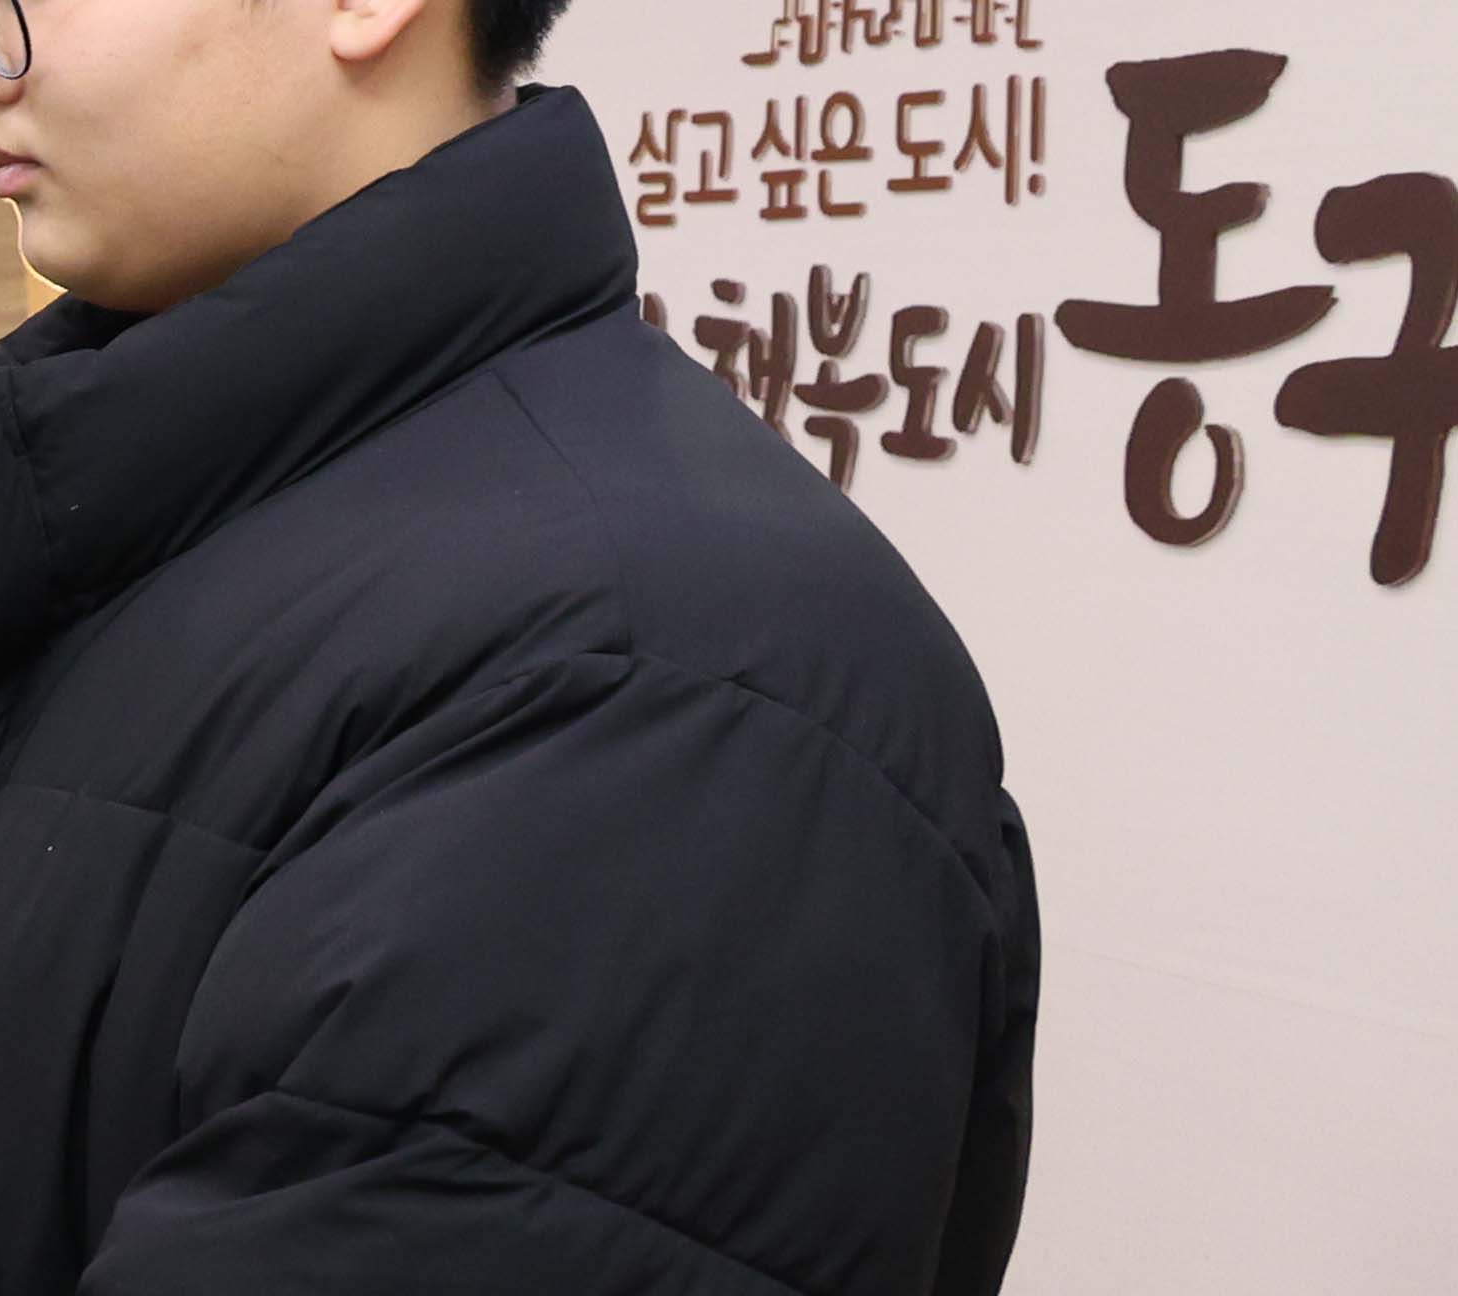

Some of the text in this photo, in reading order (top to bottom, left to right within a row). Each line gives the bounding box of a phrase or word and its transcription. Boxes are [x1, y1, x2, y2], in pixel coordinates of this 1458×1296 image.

[629, 74, 1047, 227] 살고 싶은 도시!
[1054, 48, 1458, 587] 동구
